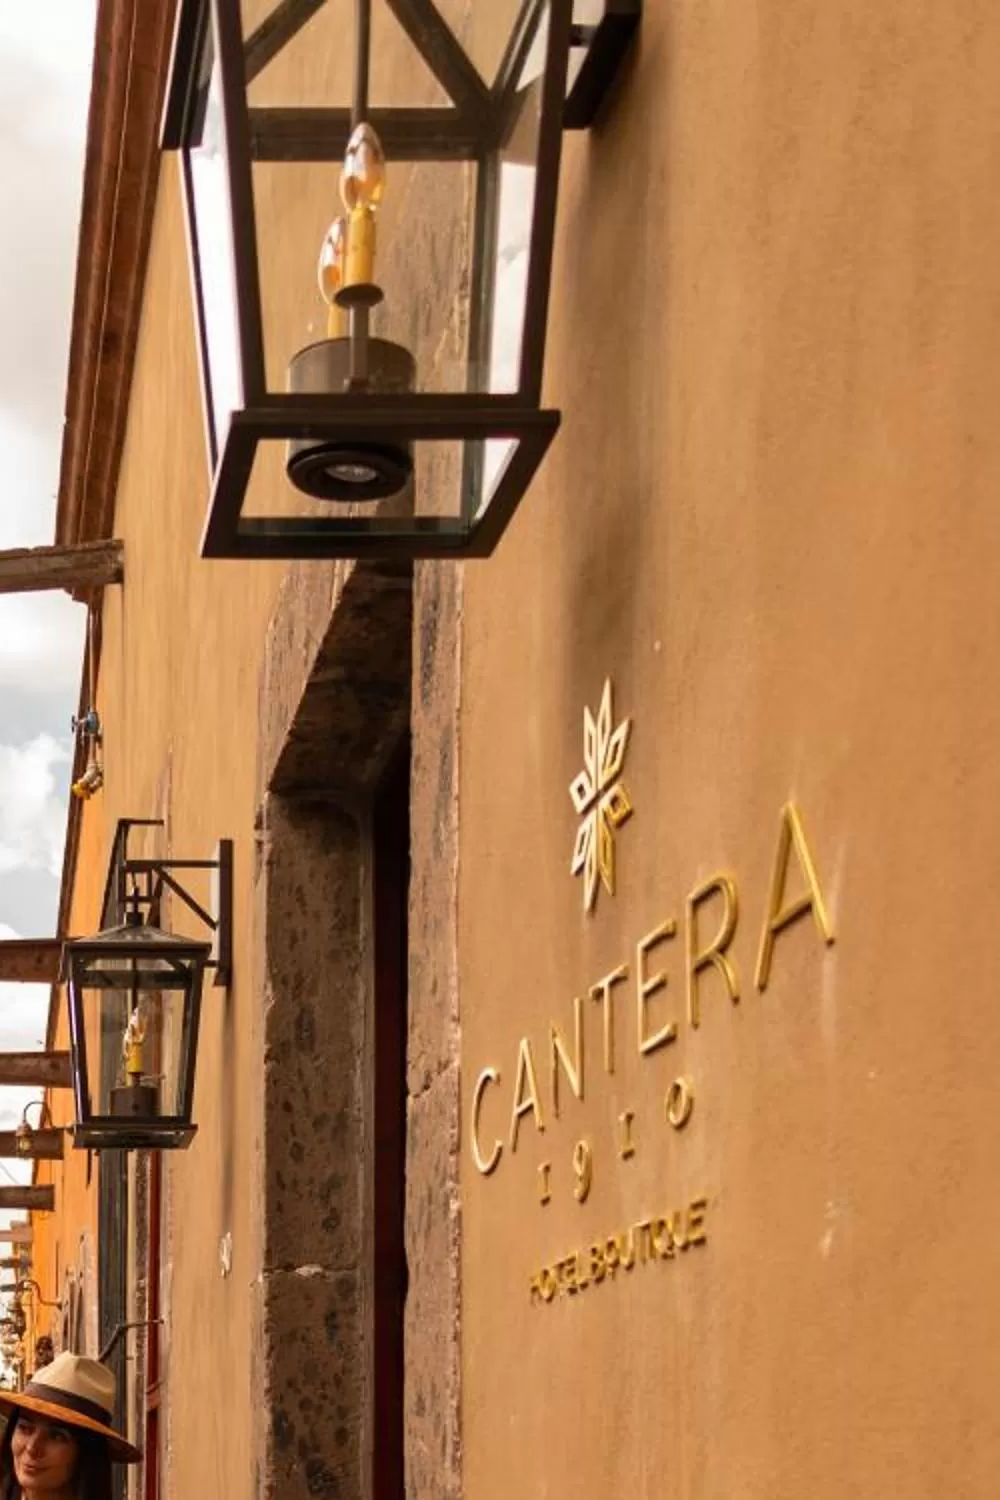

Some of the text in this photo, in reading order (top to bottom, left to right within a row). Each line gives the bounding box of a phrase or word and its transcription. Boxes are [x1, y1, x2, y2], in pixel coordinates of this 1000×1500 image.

[471, 799, 837, 1176] CANTERA
[536, 1073, 695, 1206] 1910
[590, 1198, 707, 1285] BOUTIQUE
